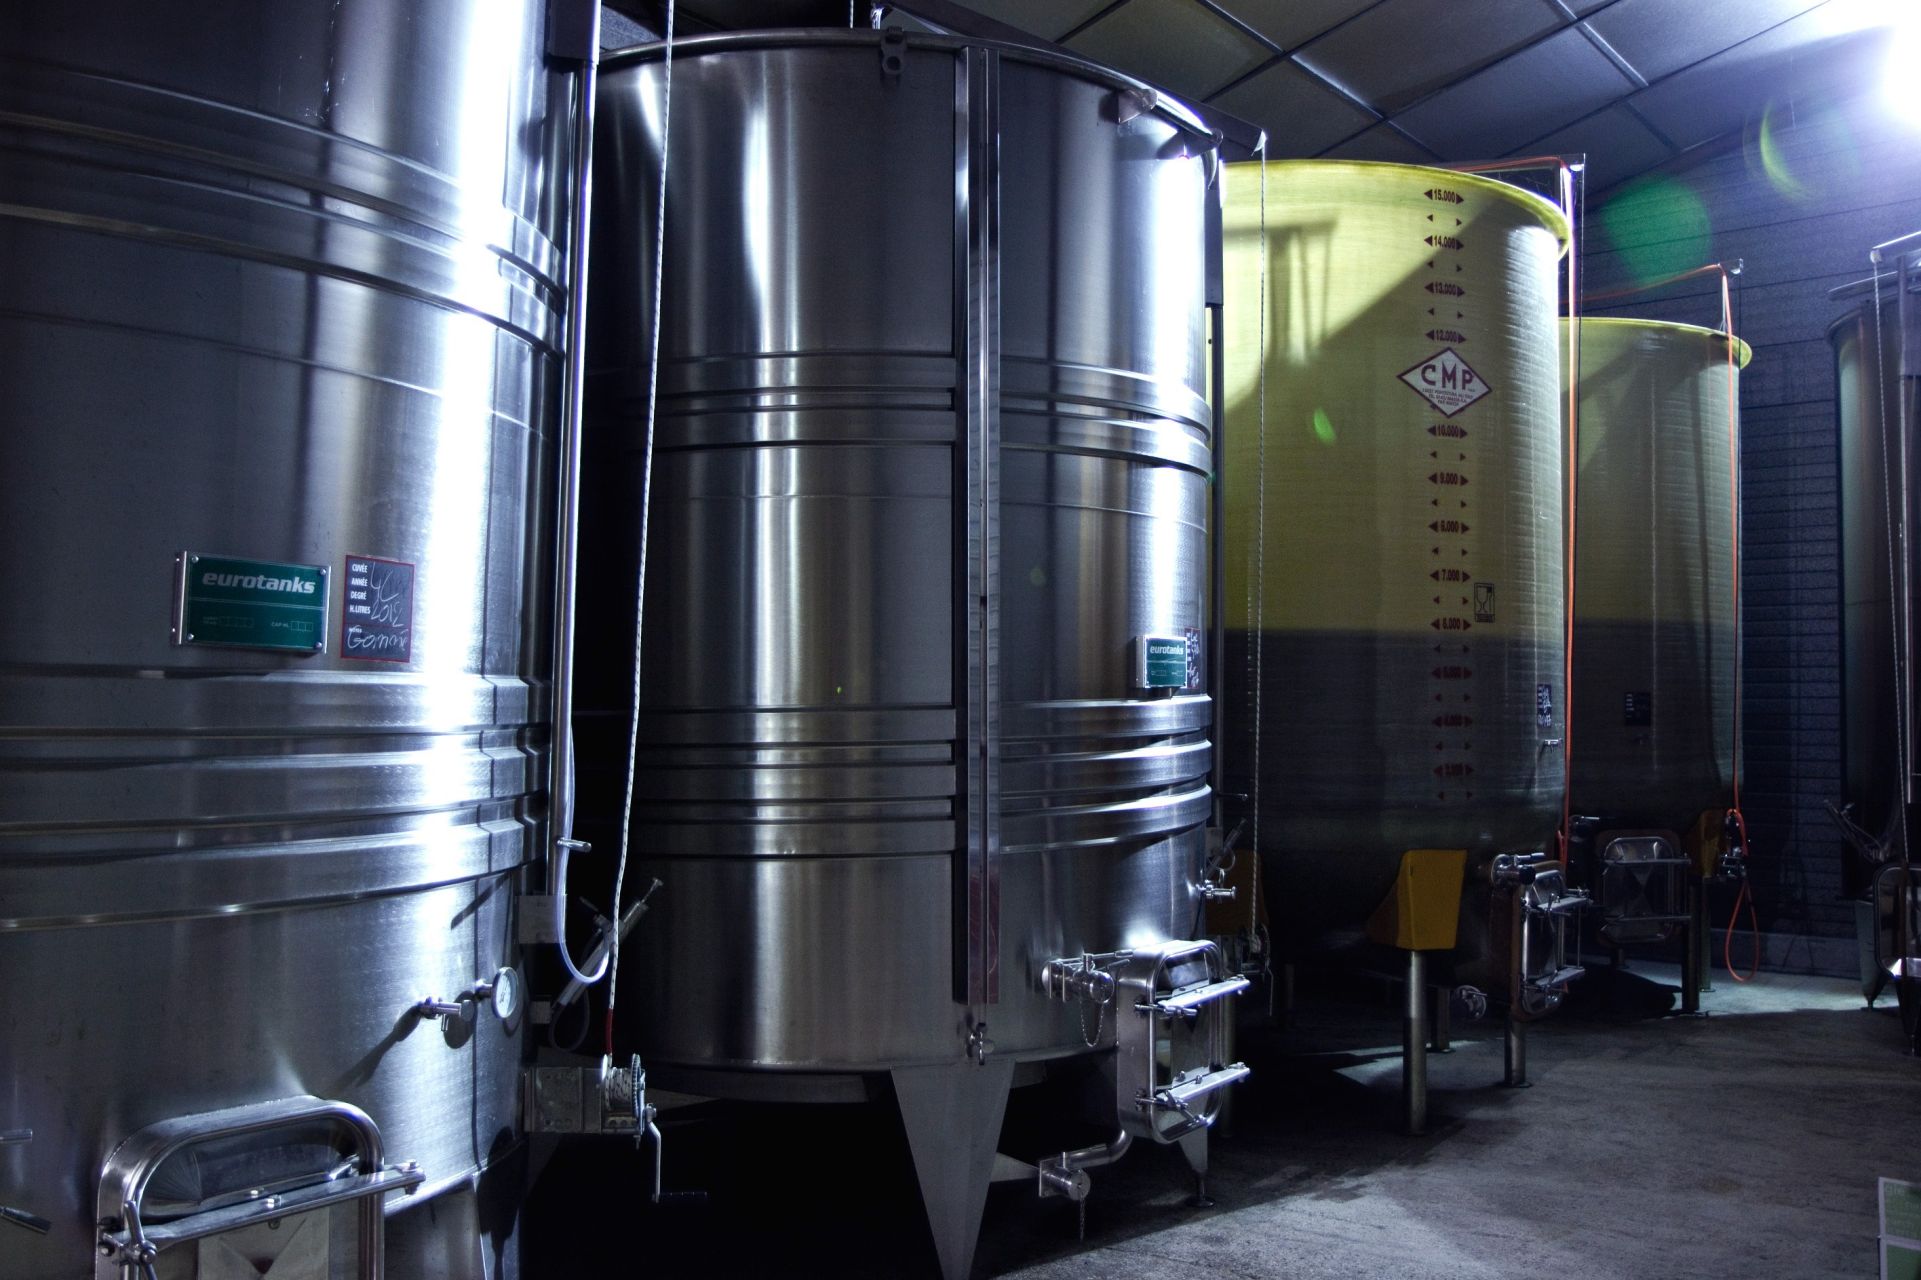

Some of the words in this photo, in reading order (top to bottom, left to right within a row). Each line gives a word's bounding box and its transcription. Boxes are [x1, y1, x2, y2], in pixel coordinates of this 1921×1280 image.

[1434, 189, 1456, 203] 15.000
[1434, 235, 1456, 250] 14.000
[1434, 281, 1457, 296] 13.000
[1435, 328, 1458, 343] 12.000
[1420, 360, 1474, 390] CMP
[1437, 426, 1459, 439] 10.000
[1440, 472, 1459, 486] 9.000
[202, 571, 316, 594] eurotanks
[1442, 569, 1460, 582] 7.000
[1149, 644, 1184, 655] eurotanks
